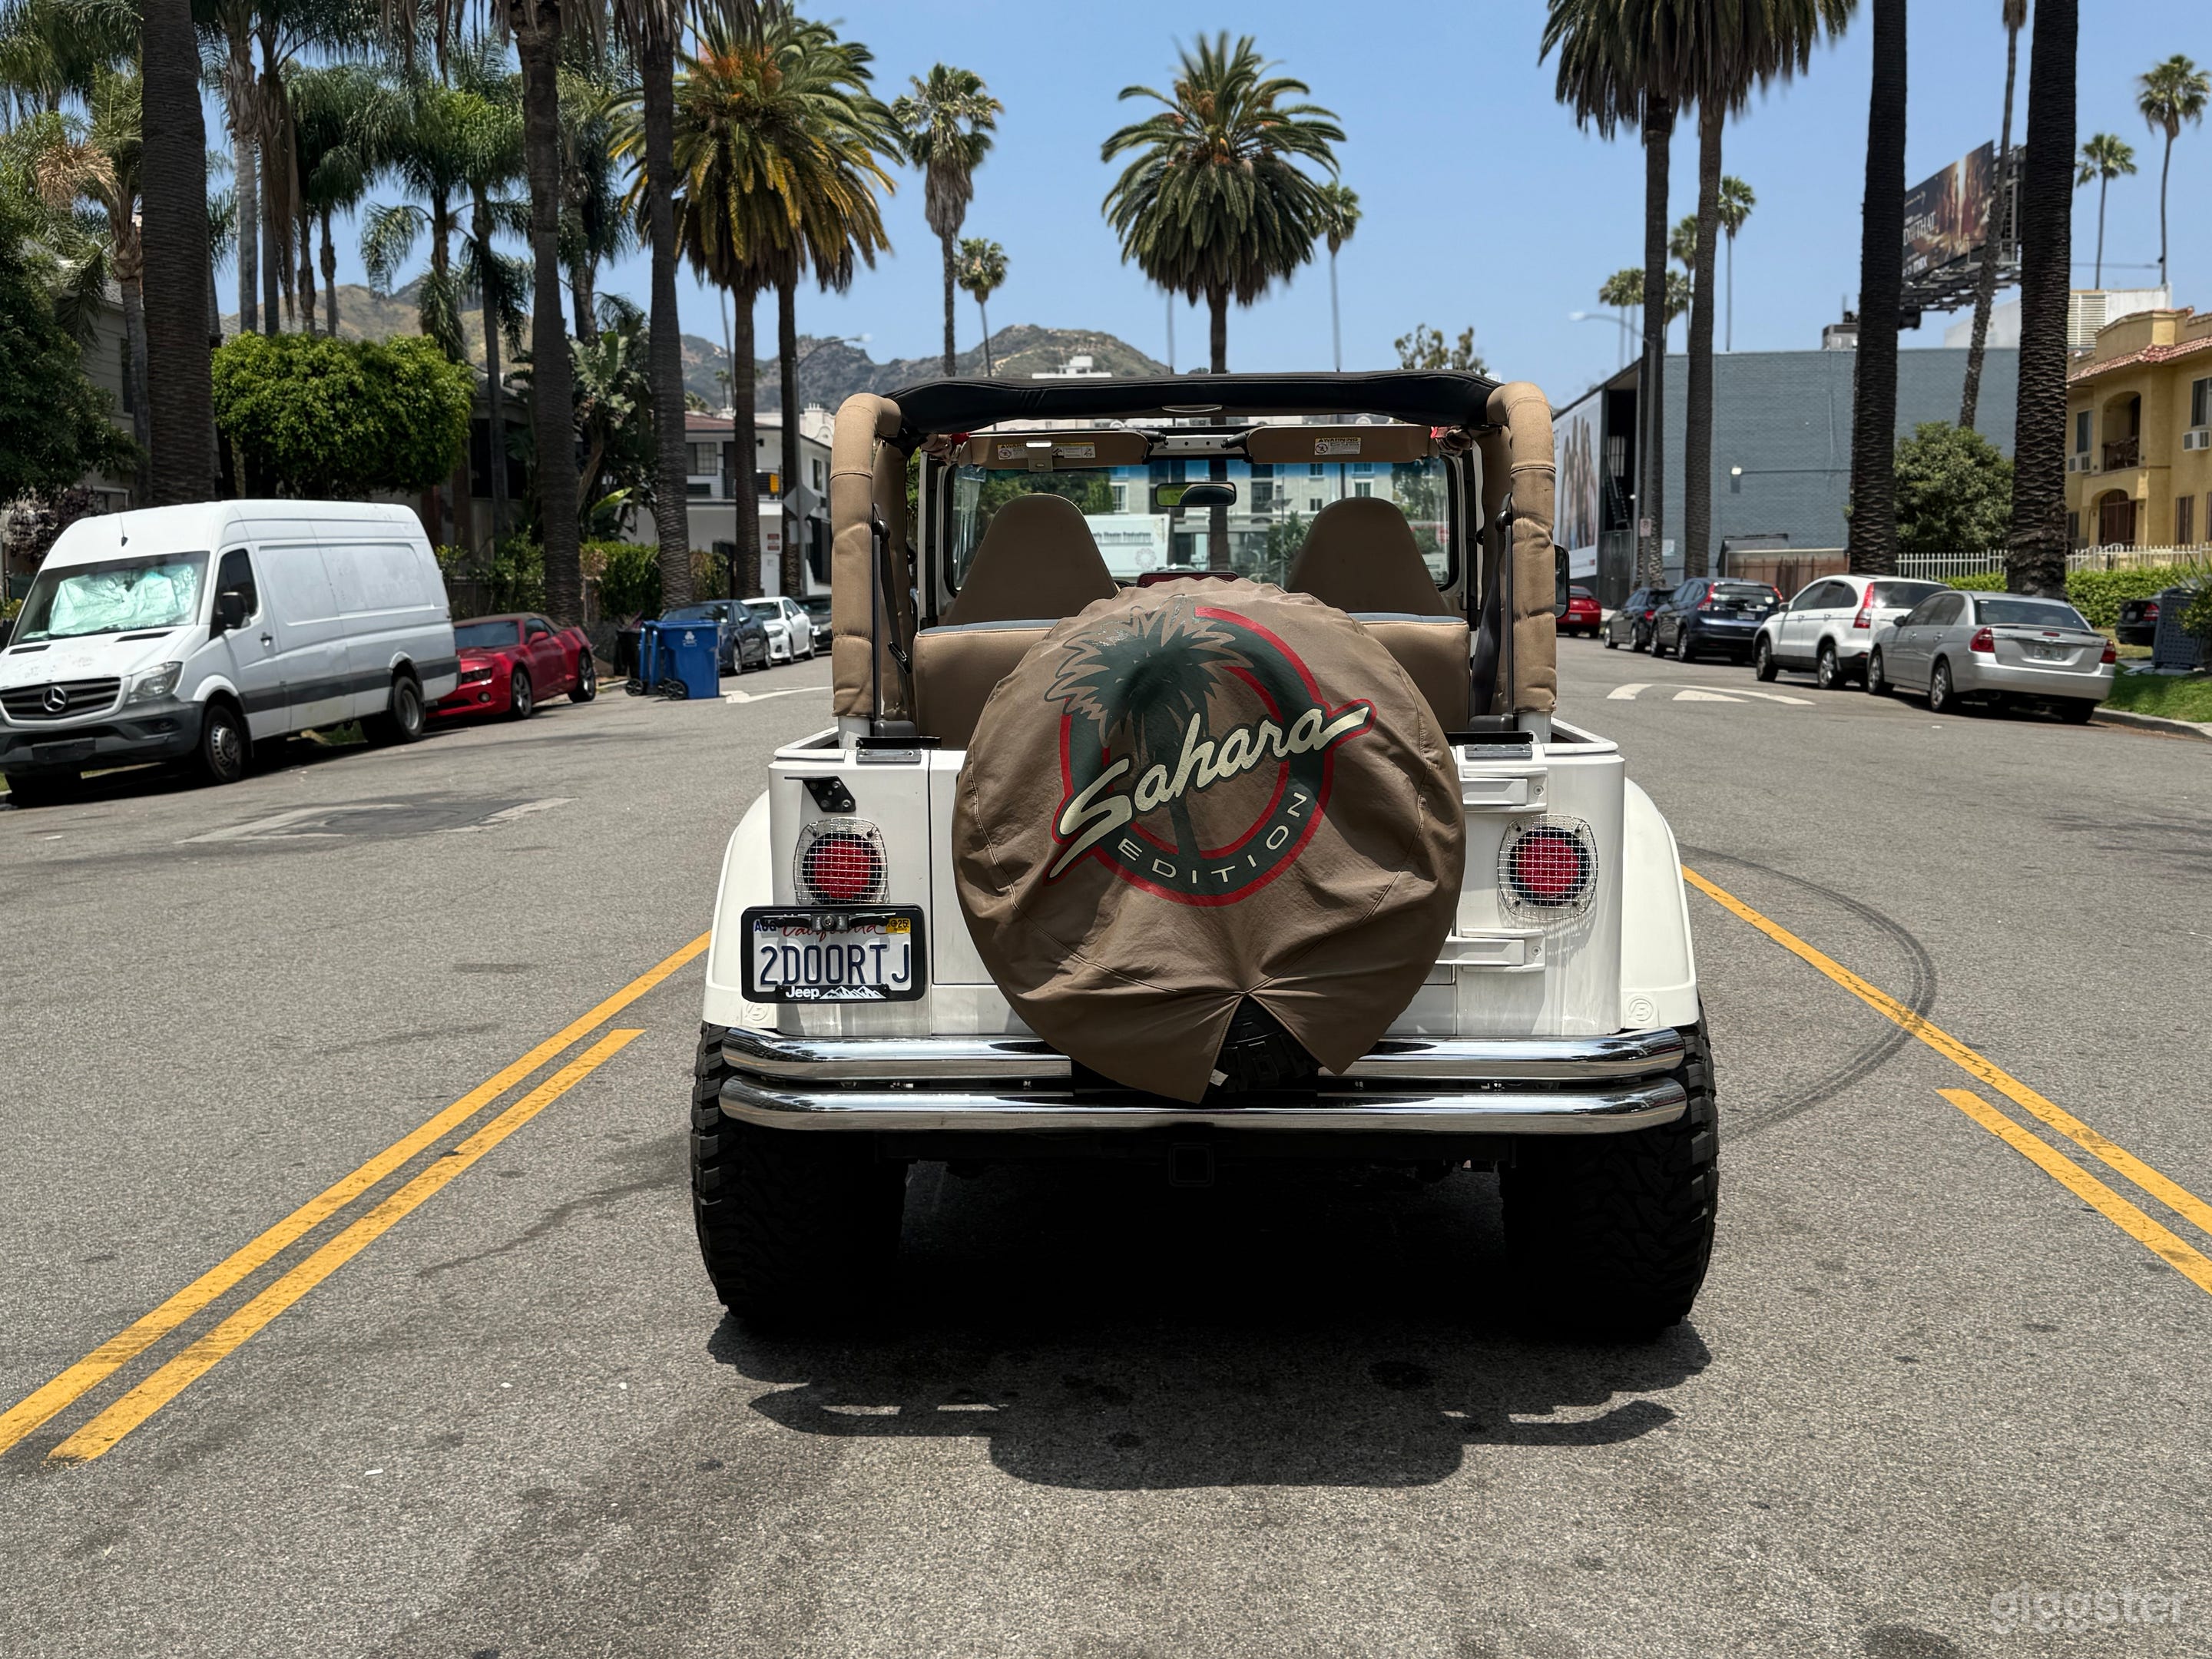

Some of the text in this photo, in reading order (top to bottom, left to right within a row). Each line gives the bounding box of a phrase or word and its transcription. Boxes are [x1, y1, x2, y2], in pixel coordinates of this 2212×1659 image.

[1049, 706, 1369, 877] Sahara
[1118, 792, 1307, 883] EDITION
[785, 985, 820, 1000] Jeep
